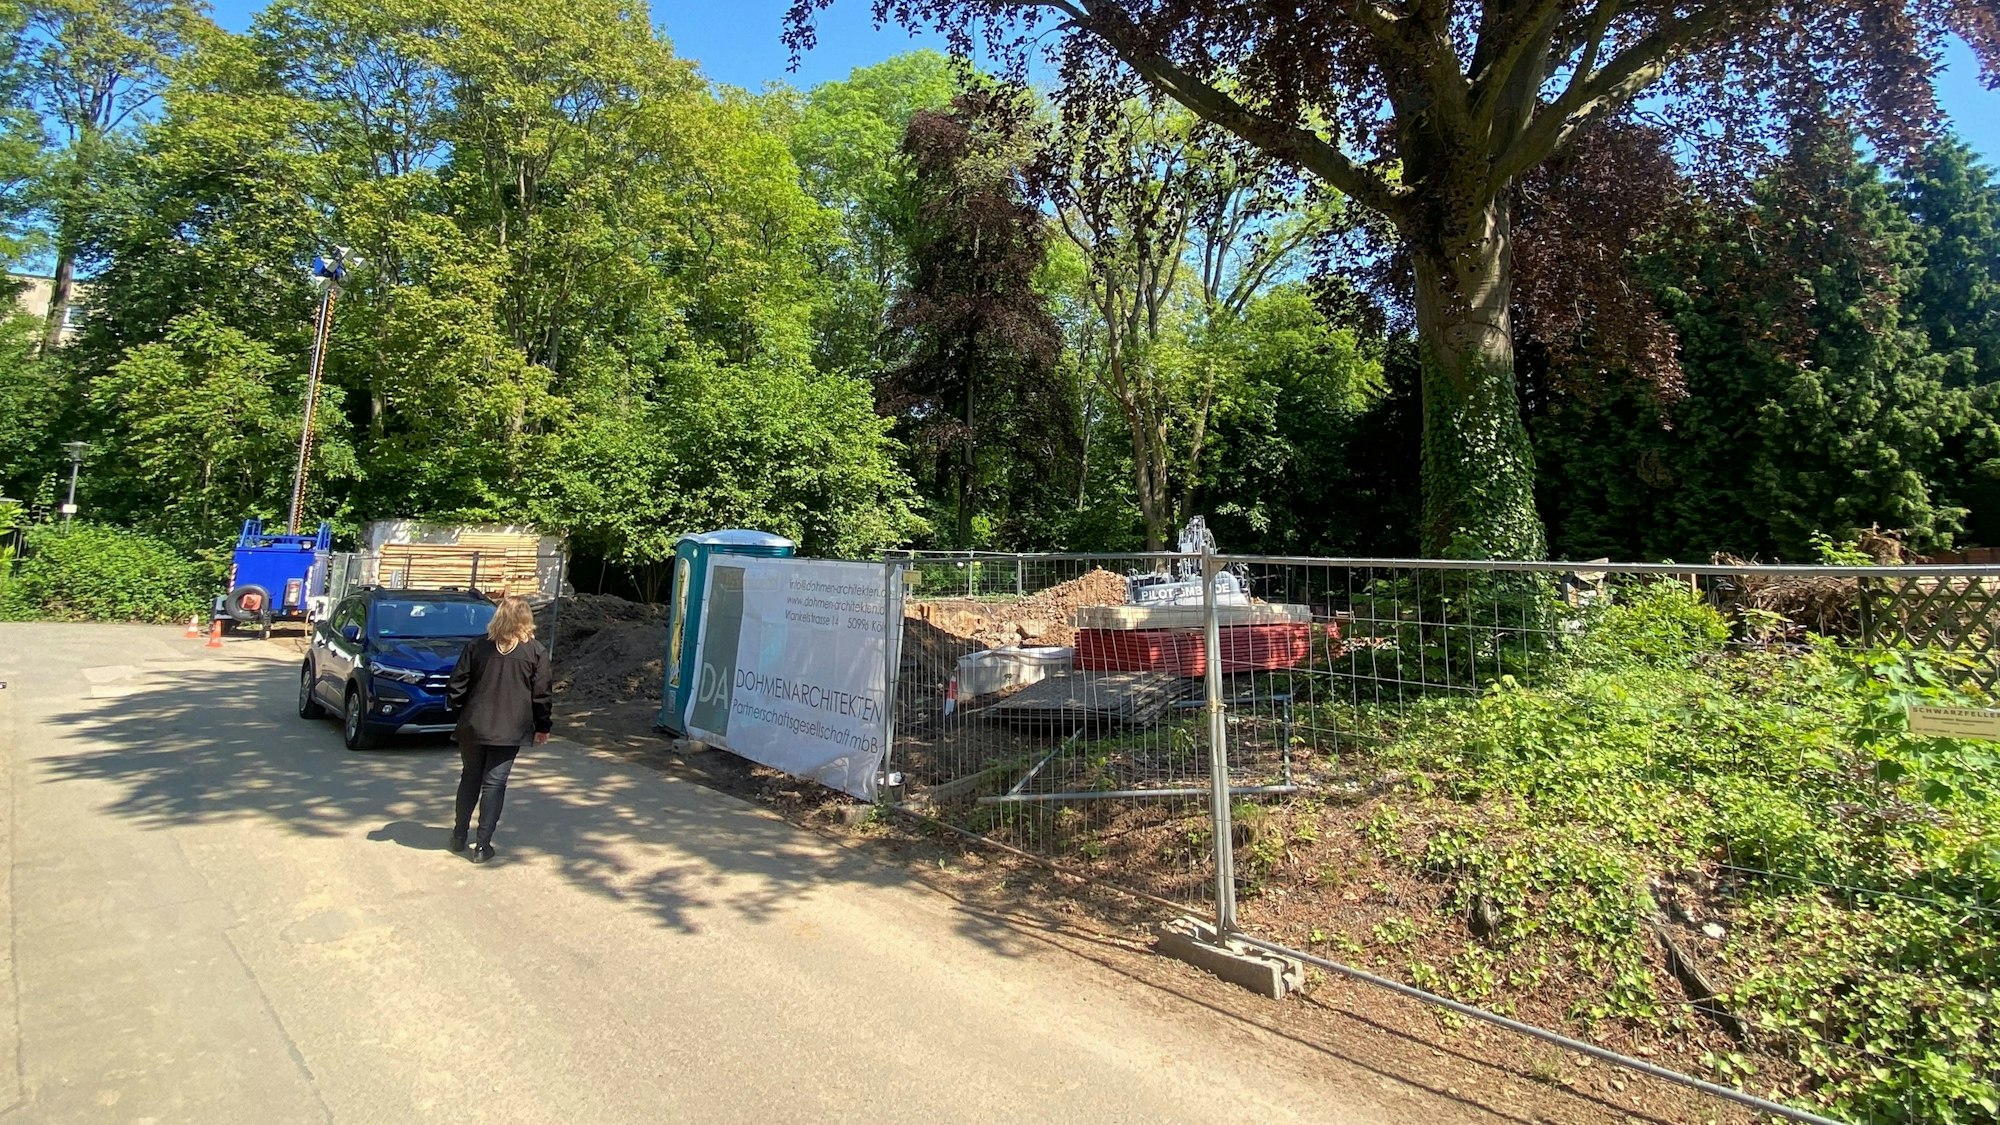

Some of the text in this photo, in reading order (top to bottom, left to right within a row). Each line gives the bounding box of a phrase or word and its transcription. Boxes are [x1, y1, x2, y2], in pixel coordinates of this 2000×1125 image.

[789, 578, 886, 598] info@dohmen-architekten.d
[786, 596, 885, 615] www.dohmen-architekten.d
[847, 616, 868, 632] 50996
[700, 662, 728, 710] DA
[736, 669, 883, 723] DOHMENARCHITEKTEN
[733, 698, 878, 754] Partnerschaftsgesellschaft mbB
